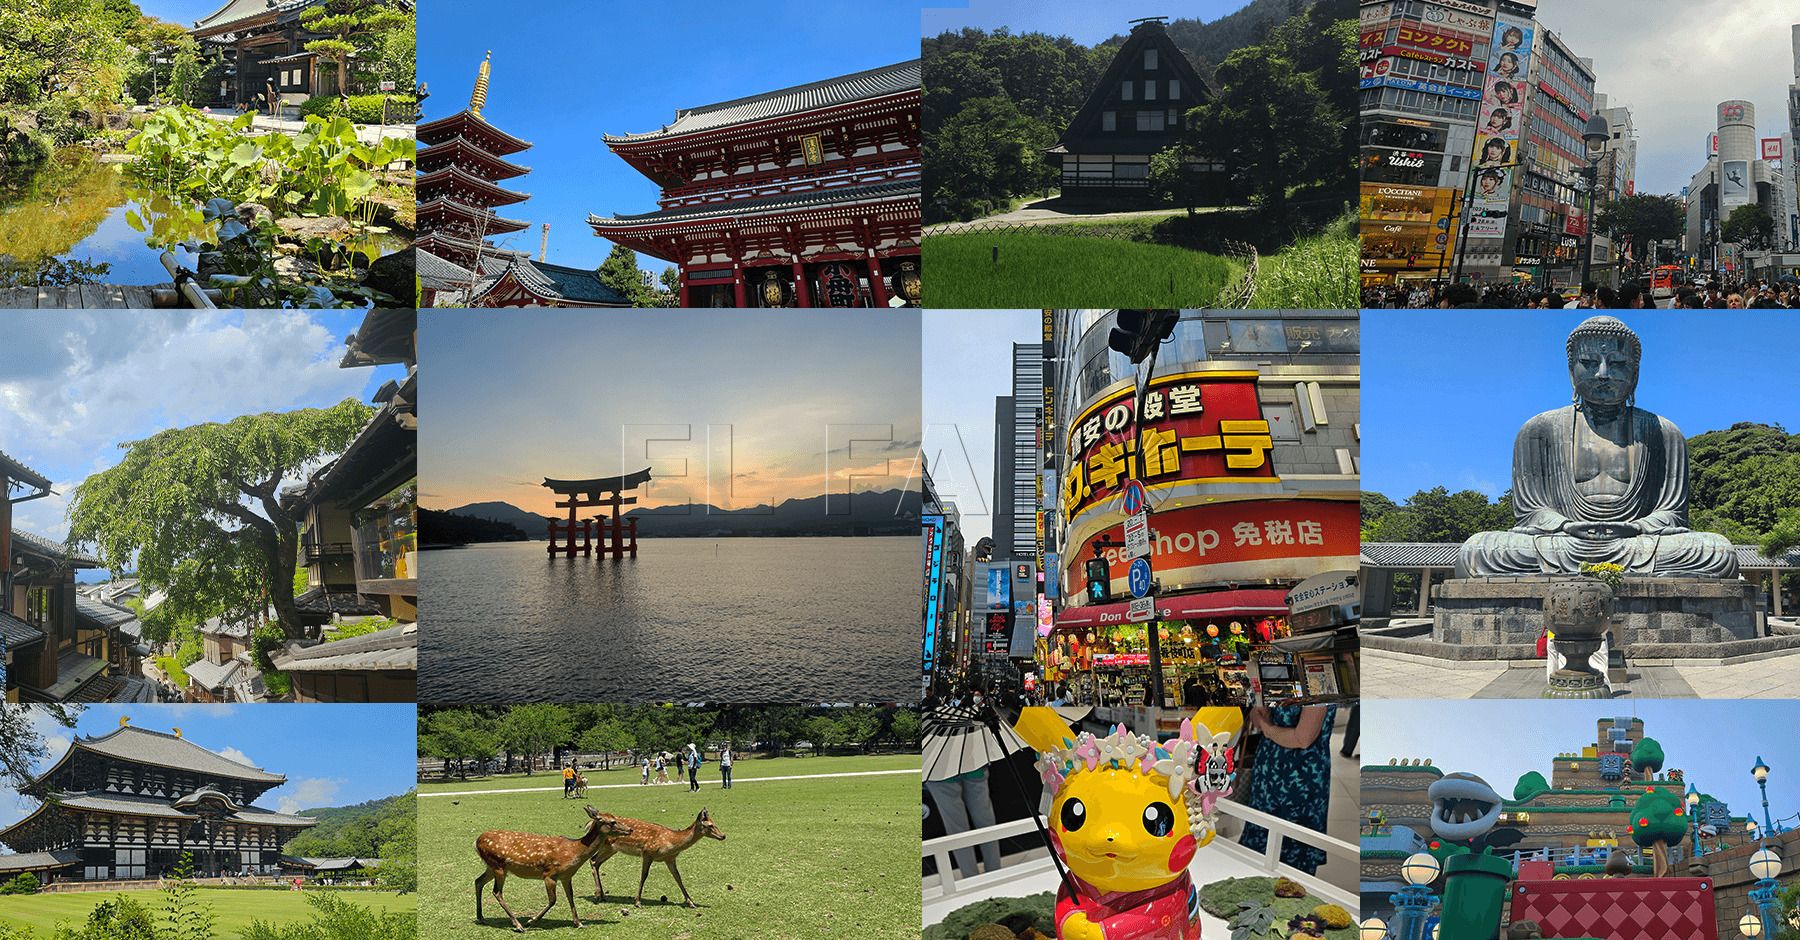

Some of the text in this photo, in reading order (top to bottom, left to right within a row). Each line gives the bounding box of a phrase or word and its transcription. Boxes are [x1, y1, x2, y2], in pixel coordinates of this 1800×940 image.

[1400, 29, 1470, 52] コンタクト
[1444, 57, 1477, 70] ガスト
[1378, 187, 1423, 196] L'OCCITANE
[1384, 225, 1402, 233] Café
[1150, 530, 1220, 556] hop
[1232, 520, 1324, 545] 免税店
[1132, 568, 1141, 593] P
[1100, 612, 1121, 622] Don
